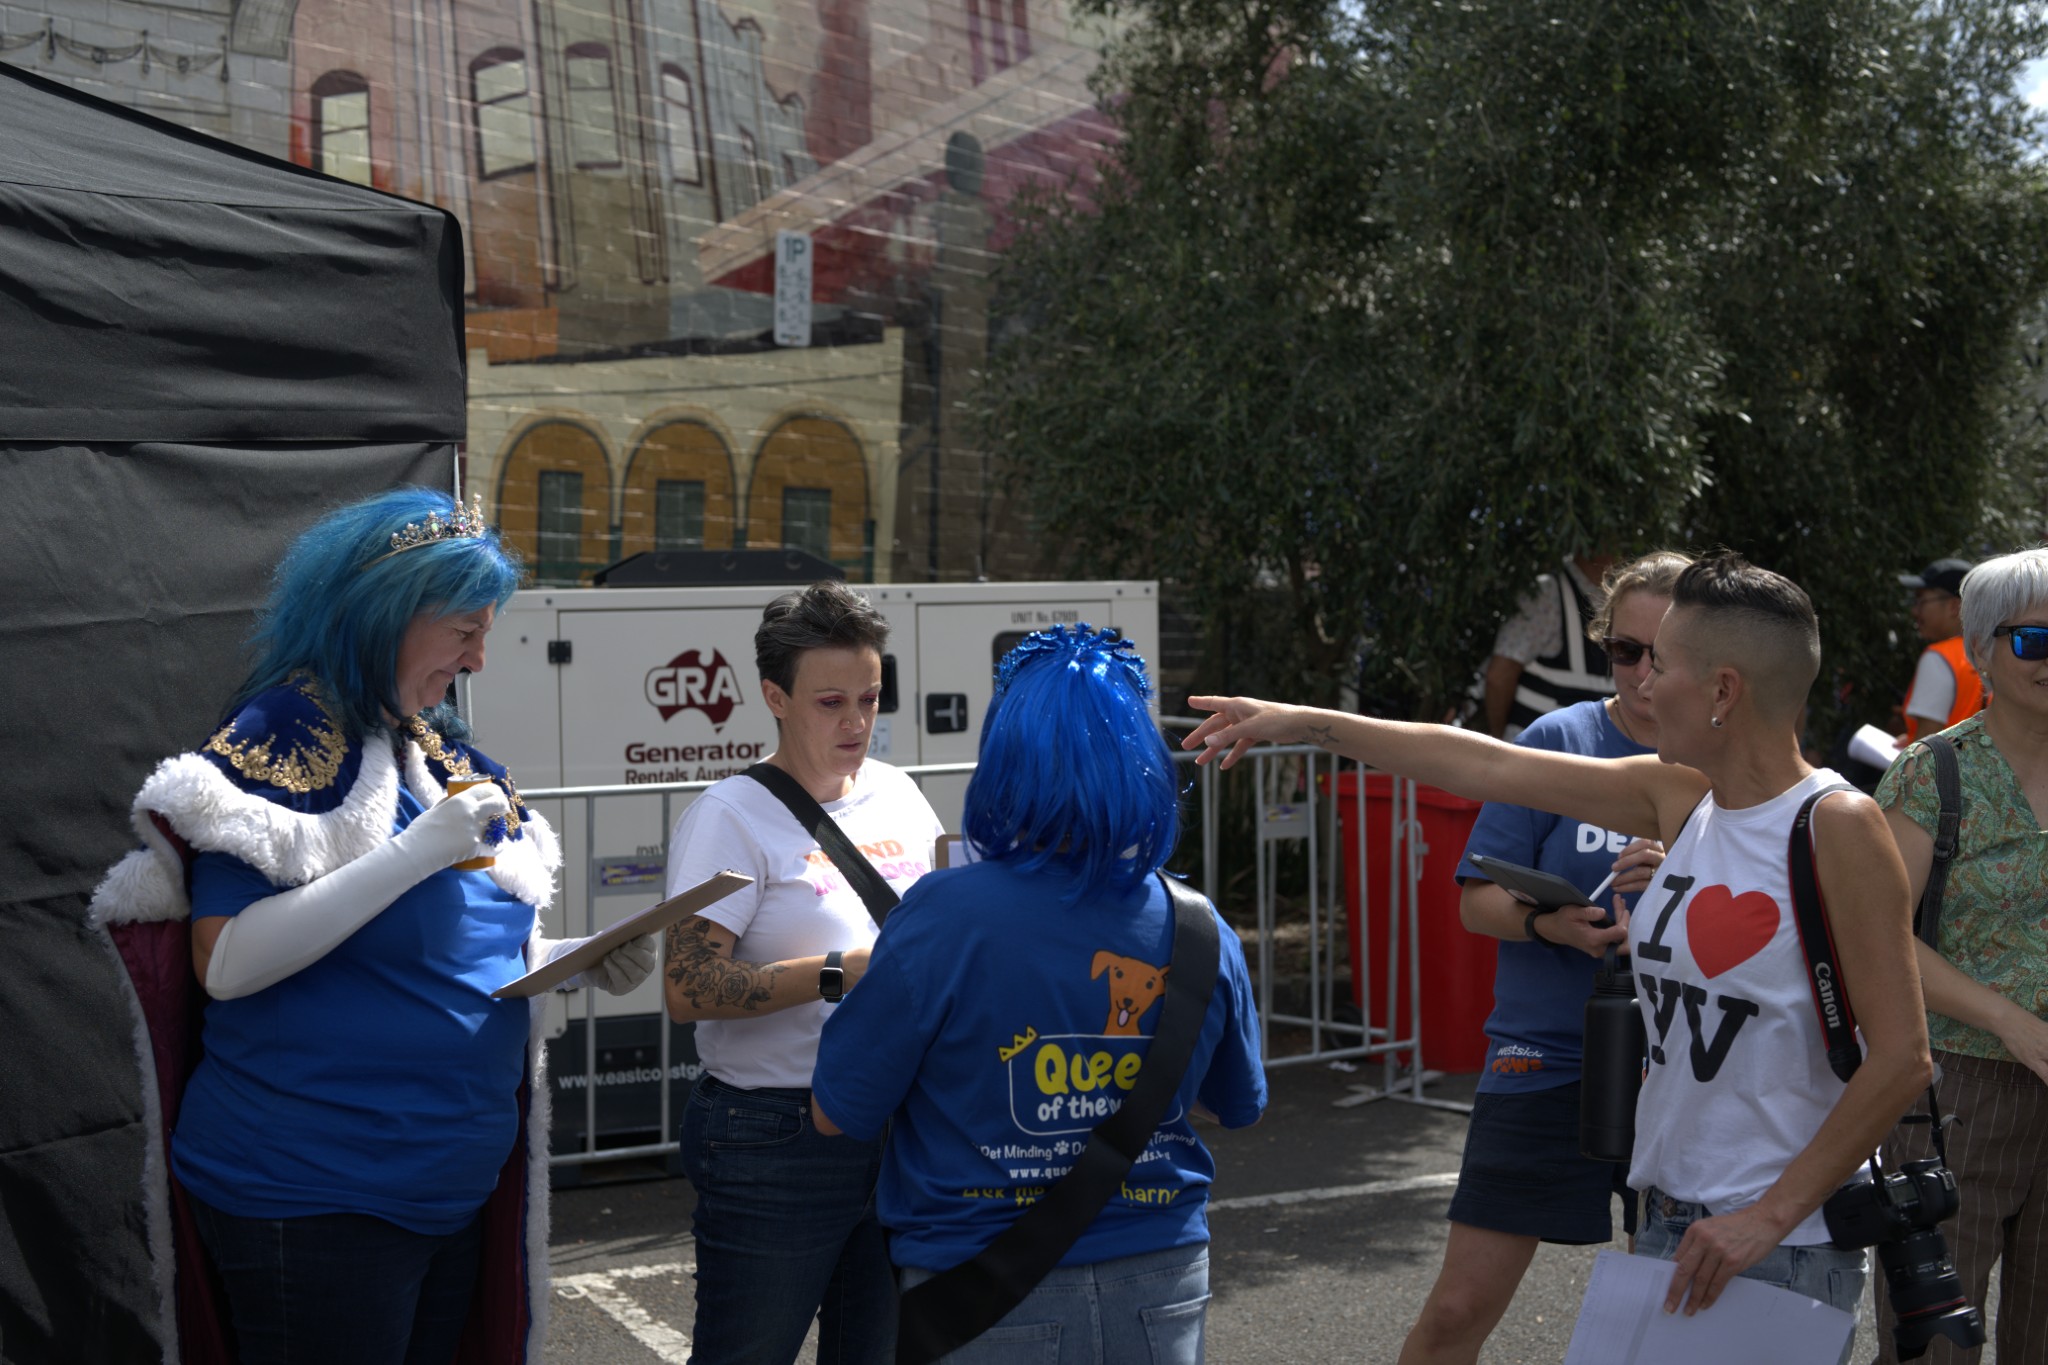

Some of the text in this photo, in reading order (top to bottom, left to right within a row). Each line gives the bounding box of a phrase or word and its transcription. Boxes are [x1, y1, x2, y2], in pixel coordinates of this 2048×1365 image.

[647, 666, 743, 707] GRA
[625, 741, 765, 763] Generator
[625, 767, 688, 785] Rentals
[1638, 873, 1695, 963] I
[1813, 961, 1841, 1029] Canon
[1034, 1043, 1142, 1095] Quee
[1037, 1095, 1064, 1122] of
[1067, 1095, 1107, 1119] the
[1004, 1144, 1053, 1161] Minding
[1153, 1131, 1196, 1147] Training
